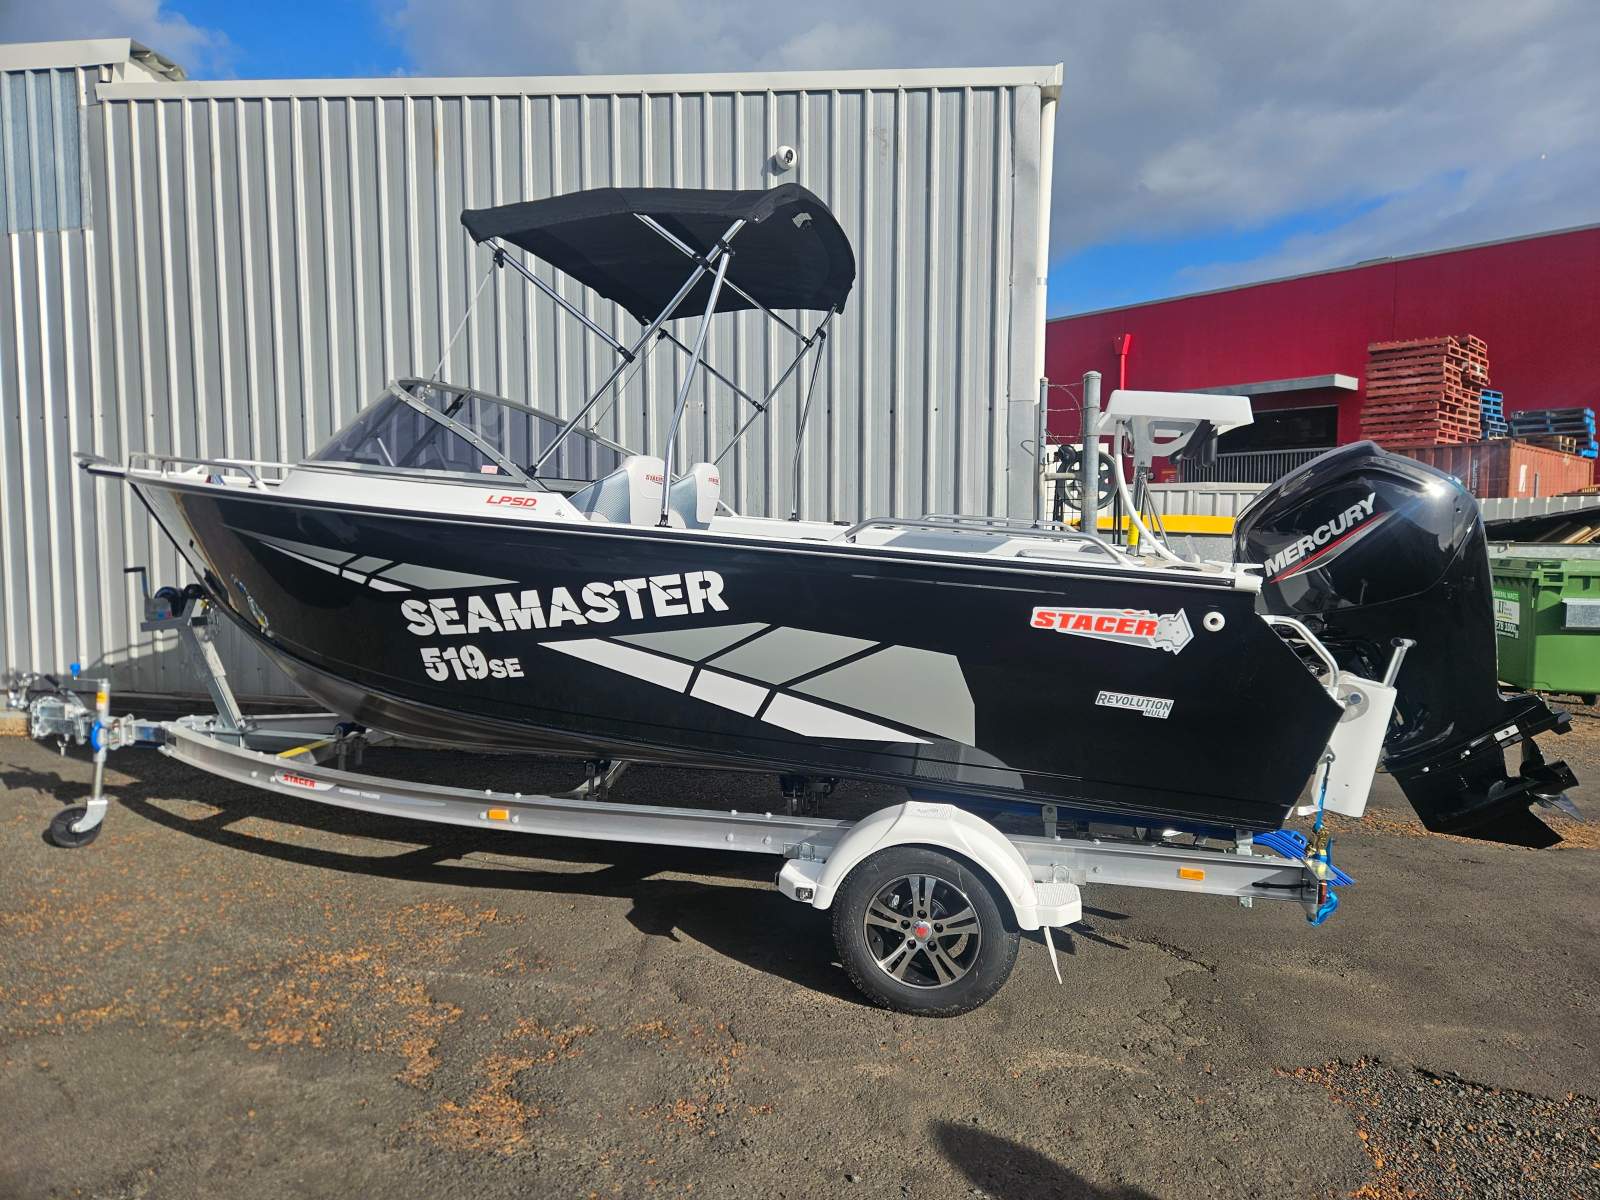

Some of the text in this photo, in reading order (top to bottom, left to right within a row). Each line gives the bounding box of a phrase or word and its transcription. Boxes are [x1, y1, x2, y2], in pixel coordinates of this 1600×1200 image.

[486, 495, 537, 507] LPSD
[1264, 492, 1376, 577] MERCURY
[401, 570, 729, 636] SEAMASTER
[1034, 611, 1159, 637] STACER
[1097, 693, 1172, 711] REVOLUTION
[1145, 708, 1168, 718] HULL
